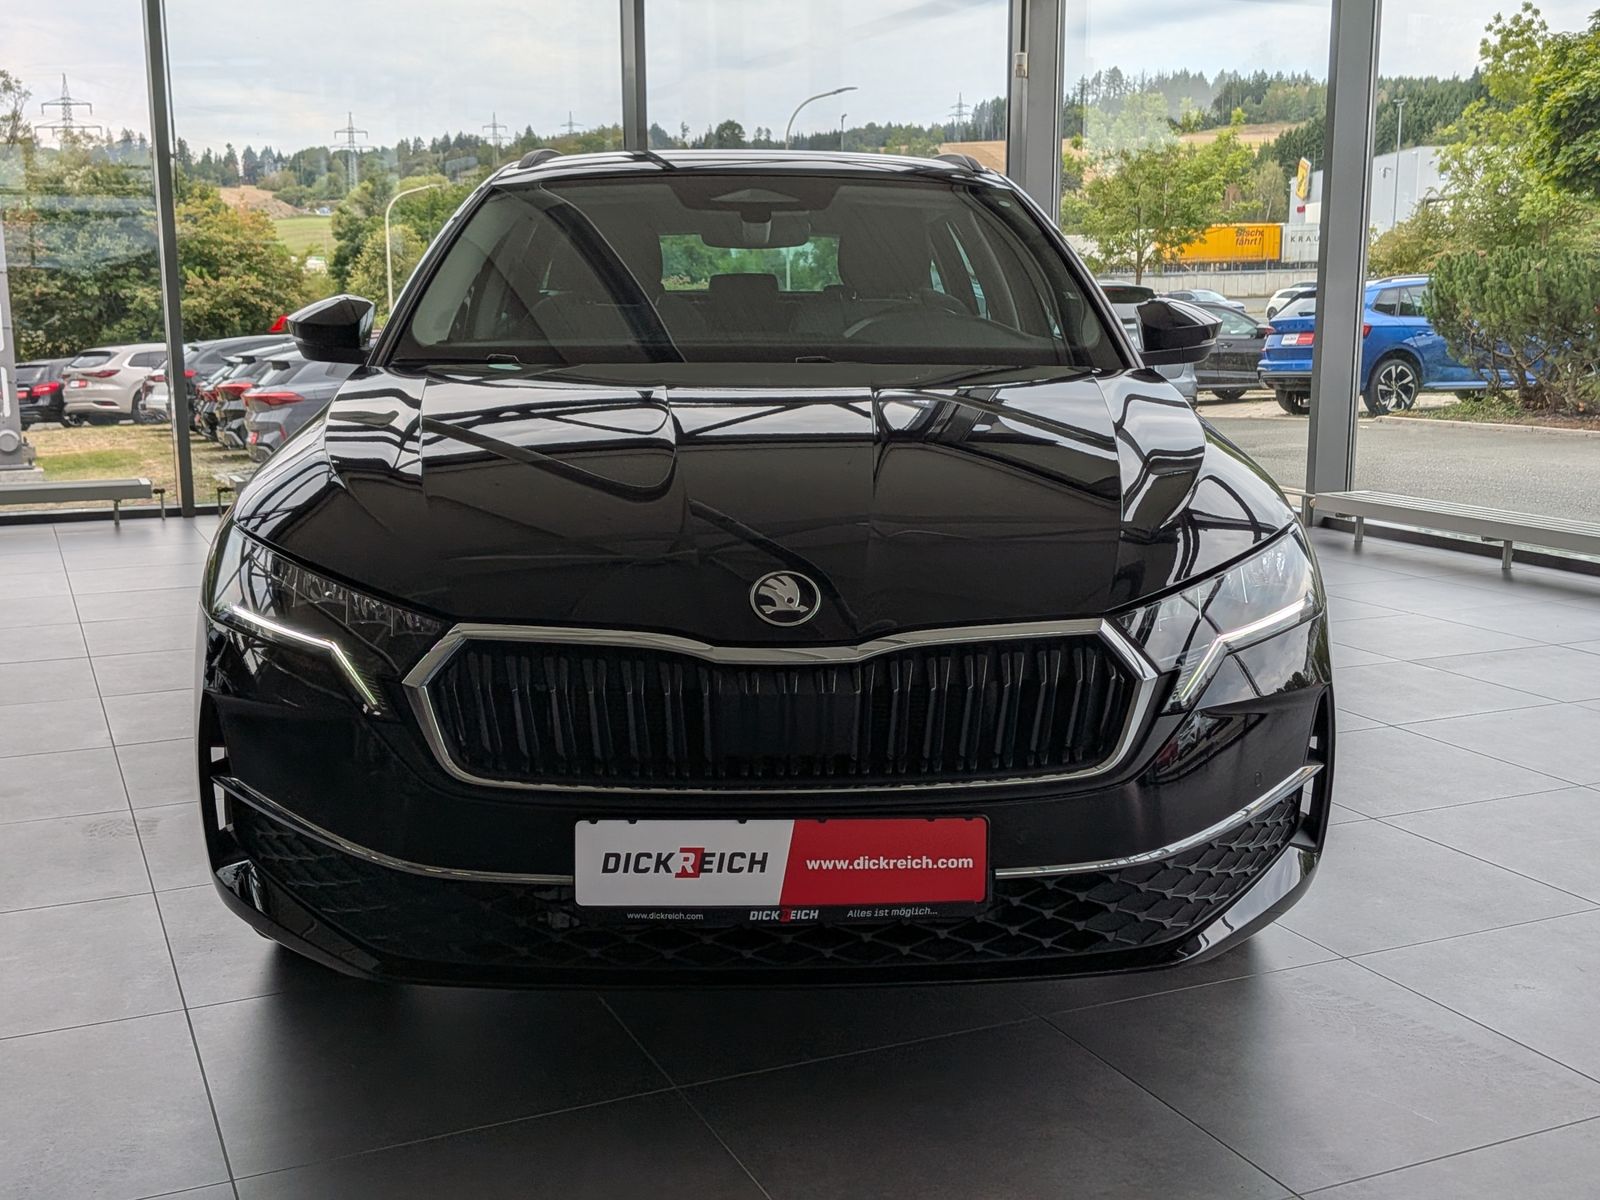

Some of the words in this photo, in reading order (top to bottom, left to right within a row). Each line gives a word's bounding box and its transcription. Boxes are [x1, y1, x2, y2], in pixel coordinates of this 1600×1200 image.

[601, 850, 768, 875] DICKREICH
[805, 855, 973, 870] www.dickreich.com
[626, 911, 704, 921] www.dickreich.com
[847, 909, 872, 918] Alles
[874, 908, 890, 917] ist
[891, 906, 938, 918] möglich...
